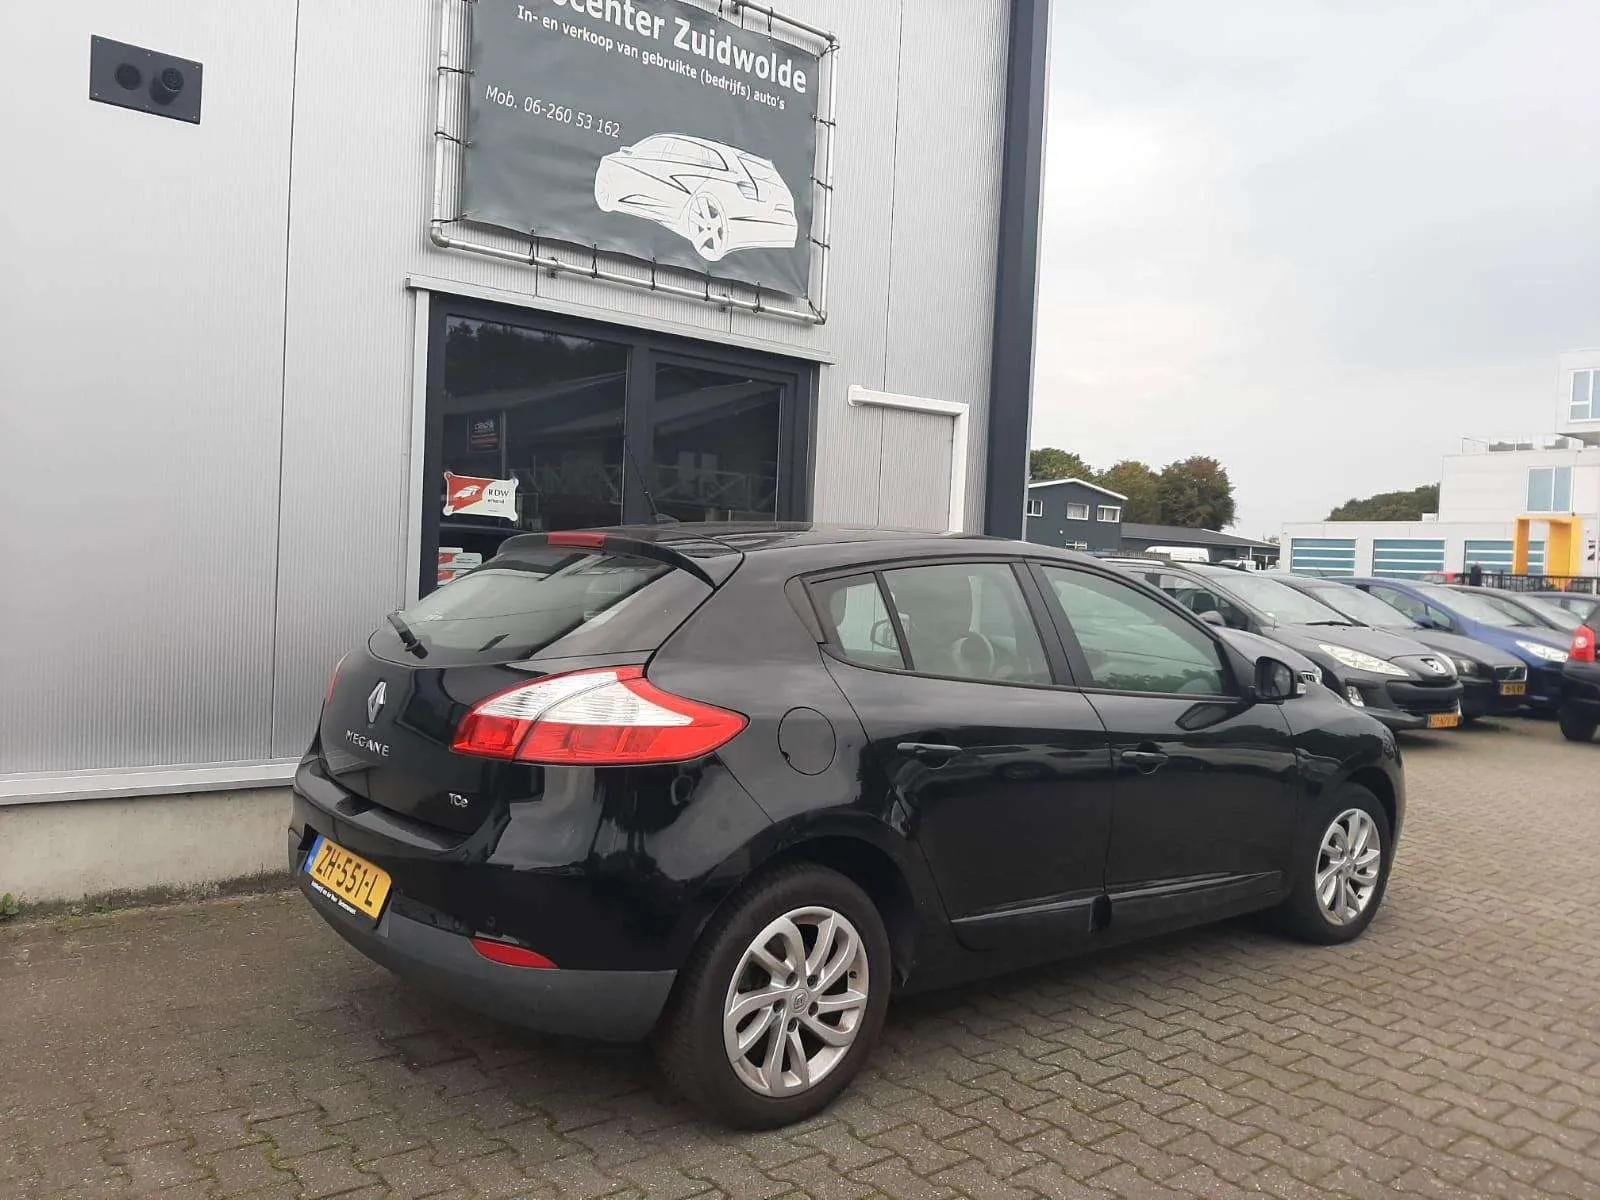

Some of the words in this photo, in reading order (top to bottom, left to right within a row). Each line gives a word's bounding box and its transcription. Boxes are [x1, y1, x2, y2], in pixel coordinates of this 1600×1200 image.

[516, 4, 539, 23] In-
[542, 16, 559, 31] en
[562, 22, 613, 52] verkoop
[616, 40, 639, 59] van
[641, 50, 698, 79] gebruikte
[700, 68, 752, 100] (bedrijfs)
[753, 90, 786, 110] auto's
[552, 0, 666, 40] center
[673, 16, 807, 94] Zuidwolde
[485, 84, 518, 109] Mob.
[523, 96, 573, 124] 06-260
[575, 111, 593, 130] 53
[596, 118, 621, 138] 162
[488, 488, 510, 497] RDW
[315, 843, 379, 908] ZH-551-L
